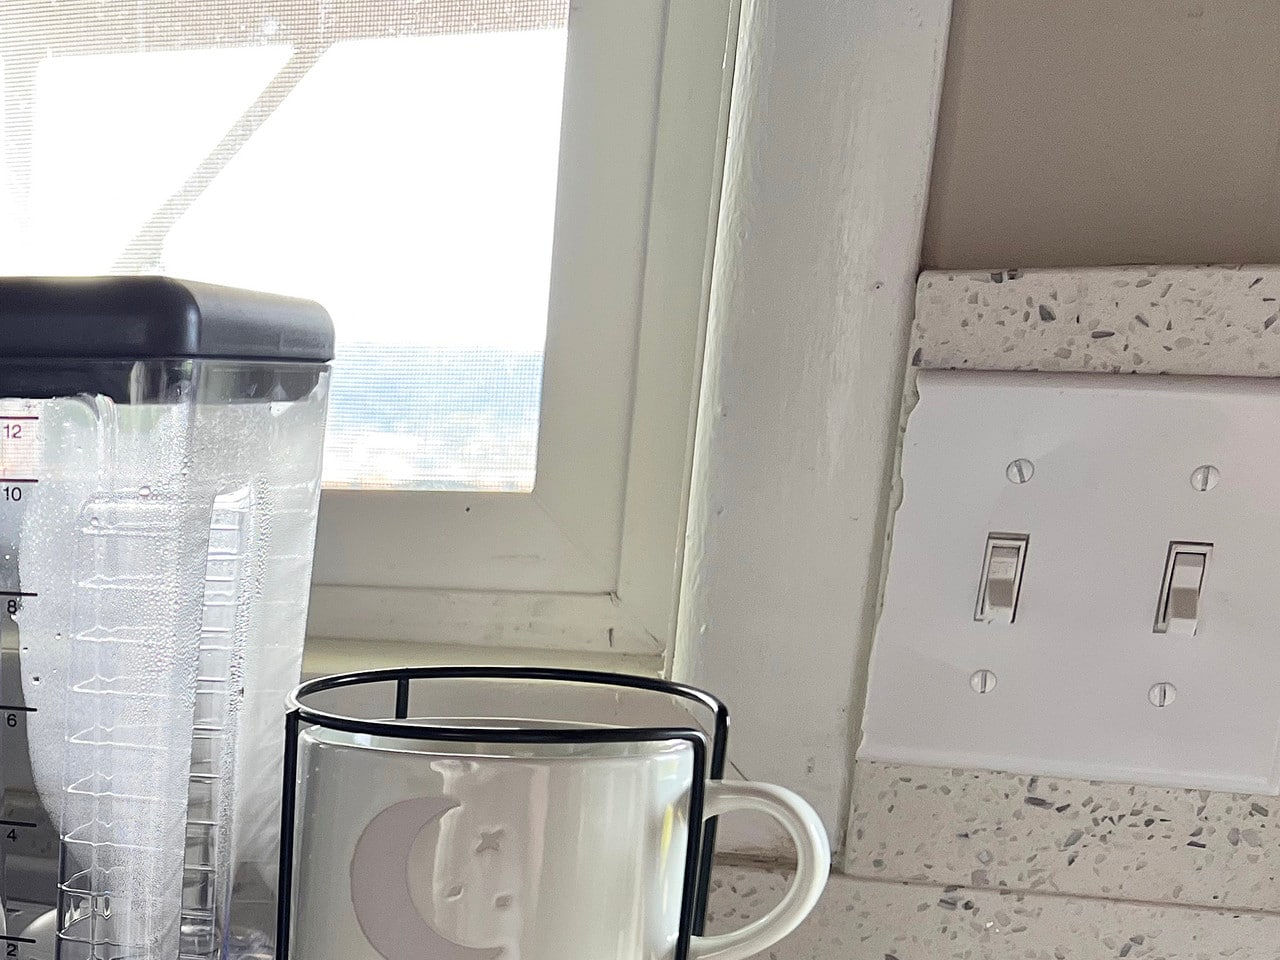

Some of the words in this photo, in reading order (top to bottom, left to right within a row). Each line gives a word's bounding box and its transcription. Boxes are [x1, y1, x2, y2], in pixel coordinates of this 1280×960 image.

[3, 424, 22, 439] 12
[3, 487, 22, 501] 10
[6, 600, 18, 614] 8
[6, 714, 18, 728] 6
[6, 829, 18, 842] 4
[6, 943, 18, 957] 2
